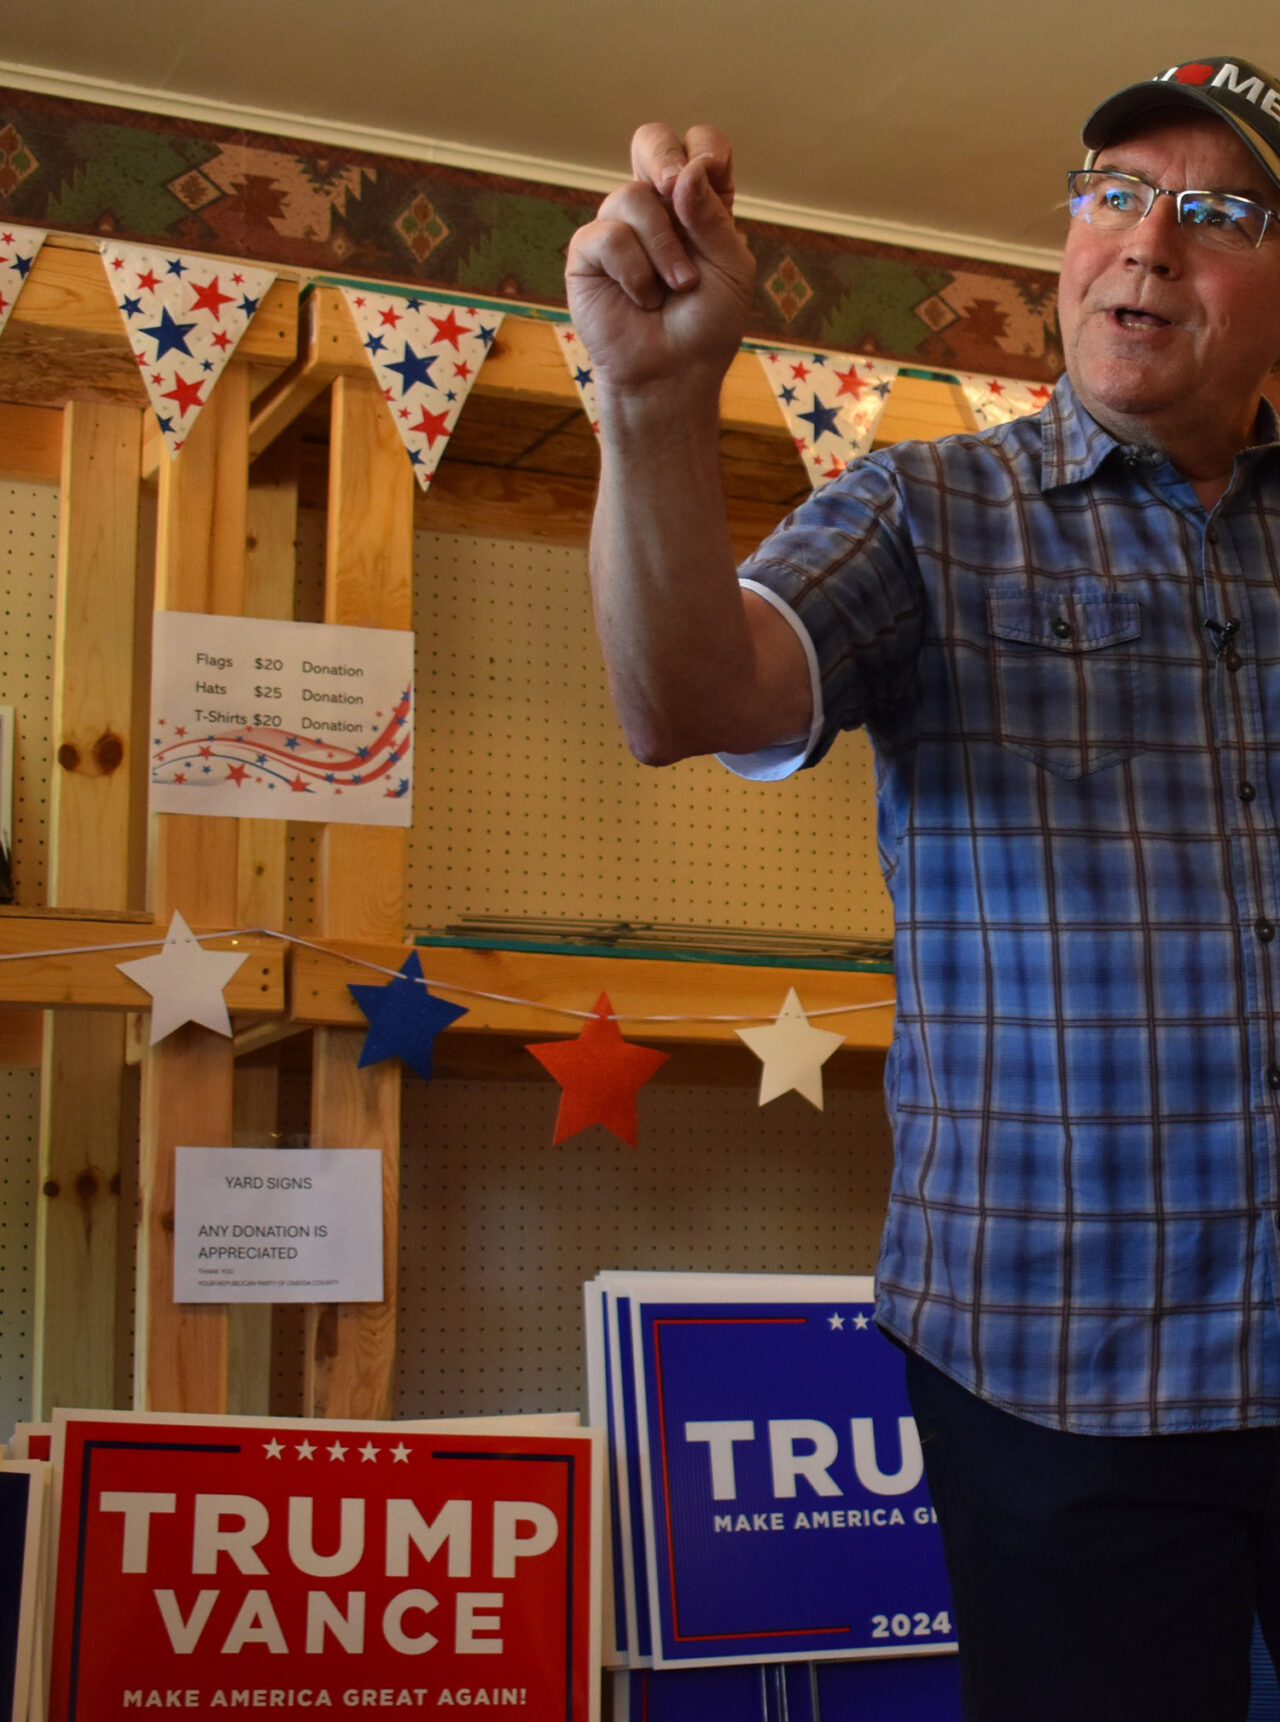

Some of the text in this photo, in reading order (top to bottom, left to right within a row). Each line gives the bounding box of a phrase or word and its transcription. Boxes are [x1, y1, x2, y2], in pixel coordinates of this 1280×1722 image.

[196, 653, 364, 677] Flags $20 Donation
[195, 681, 364, 705] Hats $25 Donation
[194, 709, 364, 733] T-Shirts $20 Donation
[225, 1176, 313, 1190] YARD SIGNS
[198, 1224, 328, 1238] ANY DONATION IS
[198, 1246, 298, 1260] APPRECIATED
[714, 1512, 786, 1533] MAKE
[793, 1508, 906, 1531] AMERICA
[99, 1490, 559, 1579] TRUMP
[153, 1588, 504, 1656] VANCE
[870, 1610, 952, 1639] 2024
[123, 1687, 528, 1709] MAKE AMERICA GREAT AGAIN!
